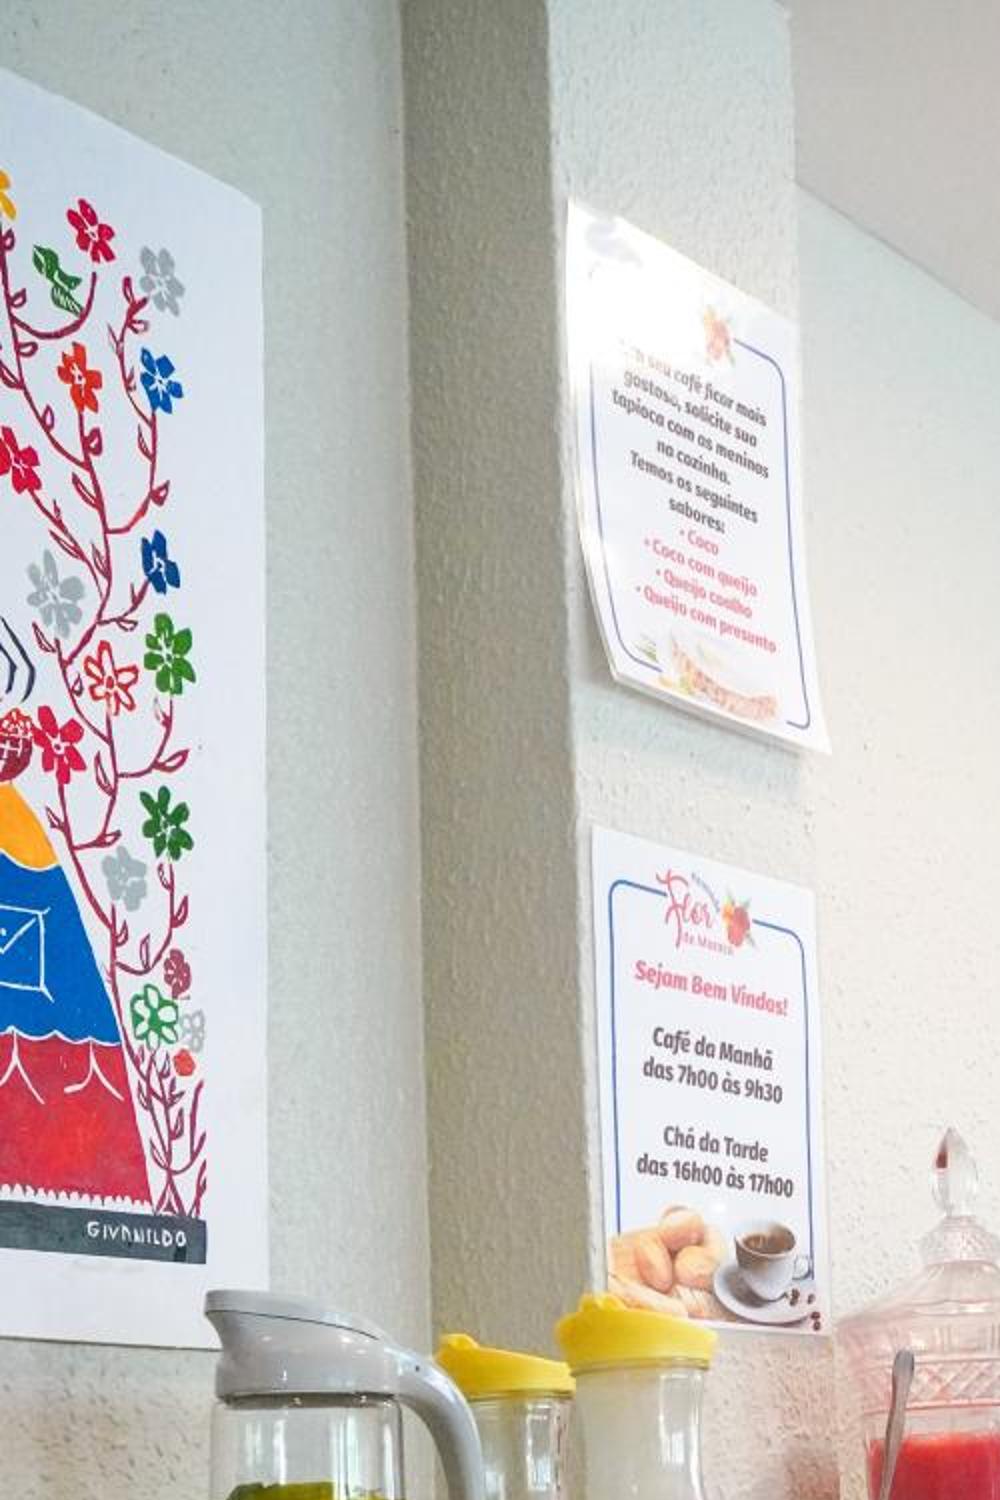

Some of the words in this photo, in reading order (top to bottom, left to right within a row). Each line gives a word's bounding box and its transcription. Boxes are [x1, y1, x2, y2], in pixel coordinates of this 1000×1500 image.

[612, 388, 665, 427] tapioca
[667, 418, 695, 442] com
[674, 370, 702, 392] café
[704, 383, 734, 409] ficar
[736, 402, 767, 427] mais
[685, 400, 732, 435] solicite
[734, 426, 757, 448] sua
[630, 449, 674, 485] Temos
[695, 484, 758, 523] seguintes
[669, 497, 725, 535] sabores:
[687, 529, 719, 556] Coco
[652, 539, 685, 565] Coco
[687, 557, 715, 578] com
[717, 571, 758, 598] queijo
[663, 568, 706, 599] Queijo
[643, 585, 687, 616] Queijo
[689, 607, 717, 632] com
[719, 620, 776, 653] presunto
[656, 869, 712, 948] Flor
[634, 958, 688, 992] Sejam
[691, 974, 727, 1002] Bem
[731, 983, 789, 1017] Vindos!
[652, 1026, 691, 1055] Café
[694, 1034, 716, 1059] da
[719, 1041, 774, 1072] Manhã
[643, 1055, 674, 1083] das
[677, 1064, 719, 1091] 7h00
[721, 1071, 742, 1096] às
[744, 1078, 783, 1104] 9h30
[663, 1125, 695, 1150] Chá
[699, 1131, 721, 1155] da
[724, 1136, 769, 1163] Tarde
[636, 1153, 669, 1178] das
[672, 1159, 723, 1187] 16h00
[725, 1165, 745, 1191] às
[749, 1172, 794, 1198] 17h00
[86, 1220, 187, 1248] GIVANILDO
